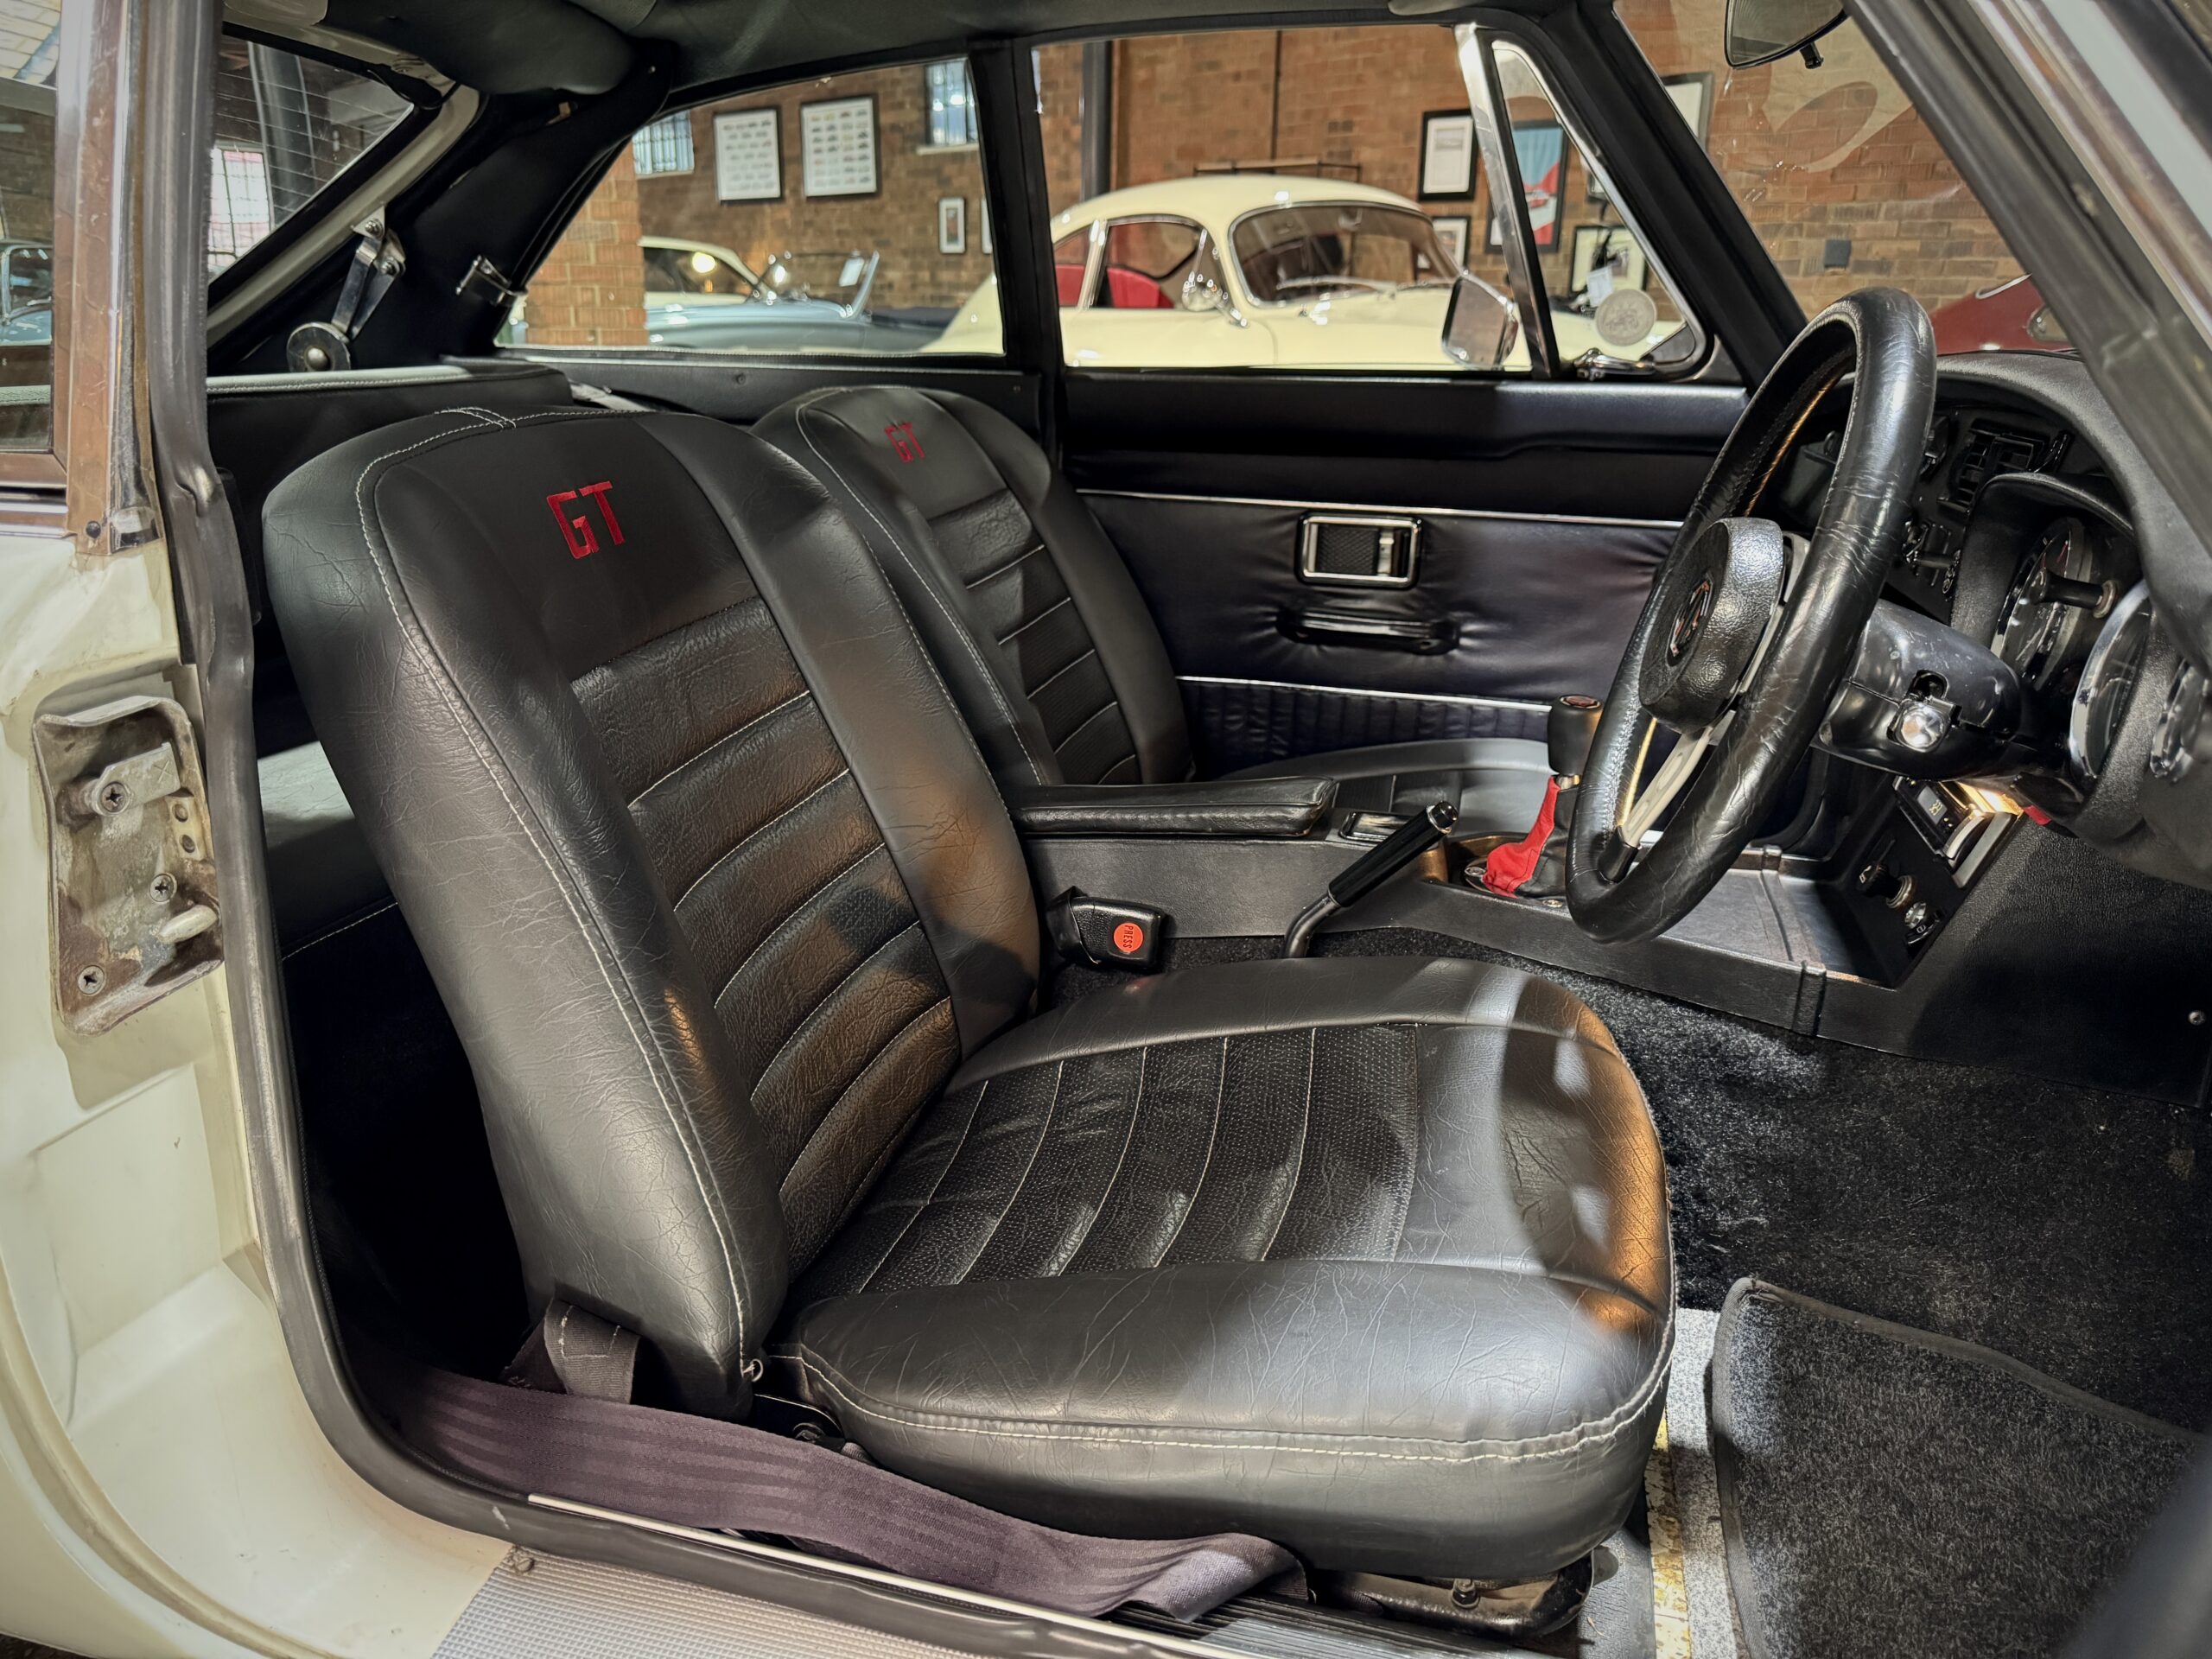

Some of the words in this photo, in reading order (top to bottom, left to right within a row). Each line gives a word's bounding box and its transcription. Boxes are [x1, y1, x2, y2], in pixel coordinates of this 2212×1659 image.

[884, 422, 925, 463] GT
[547, 480, 625, 559] GT
[1122, 925, 1134, 949] PRESS
